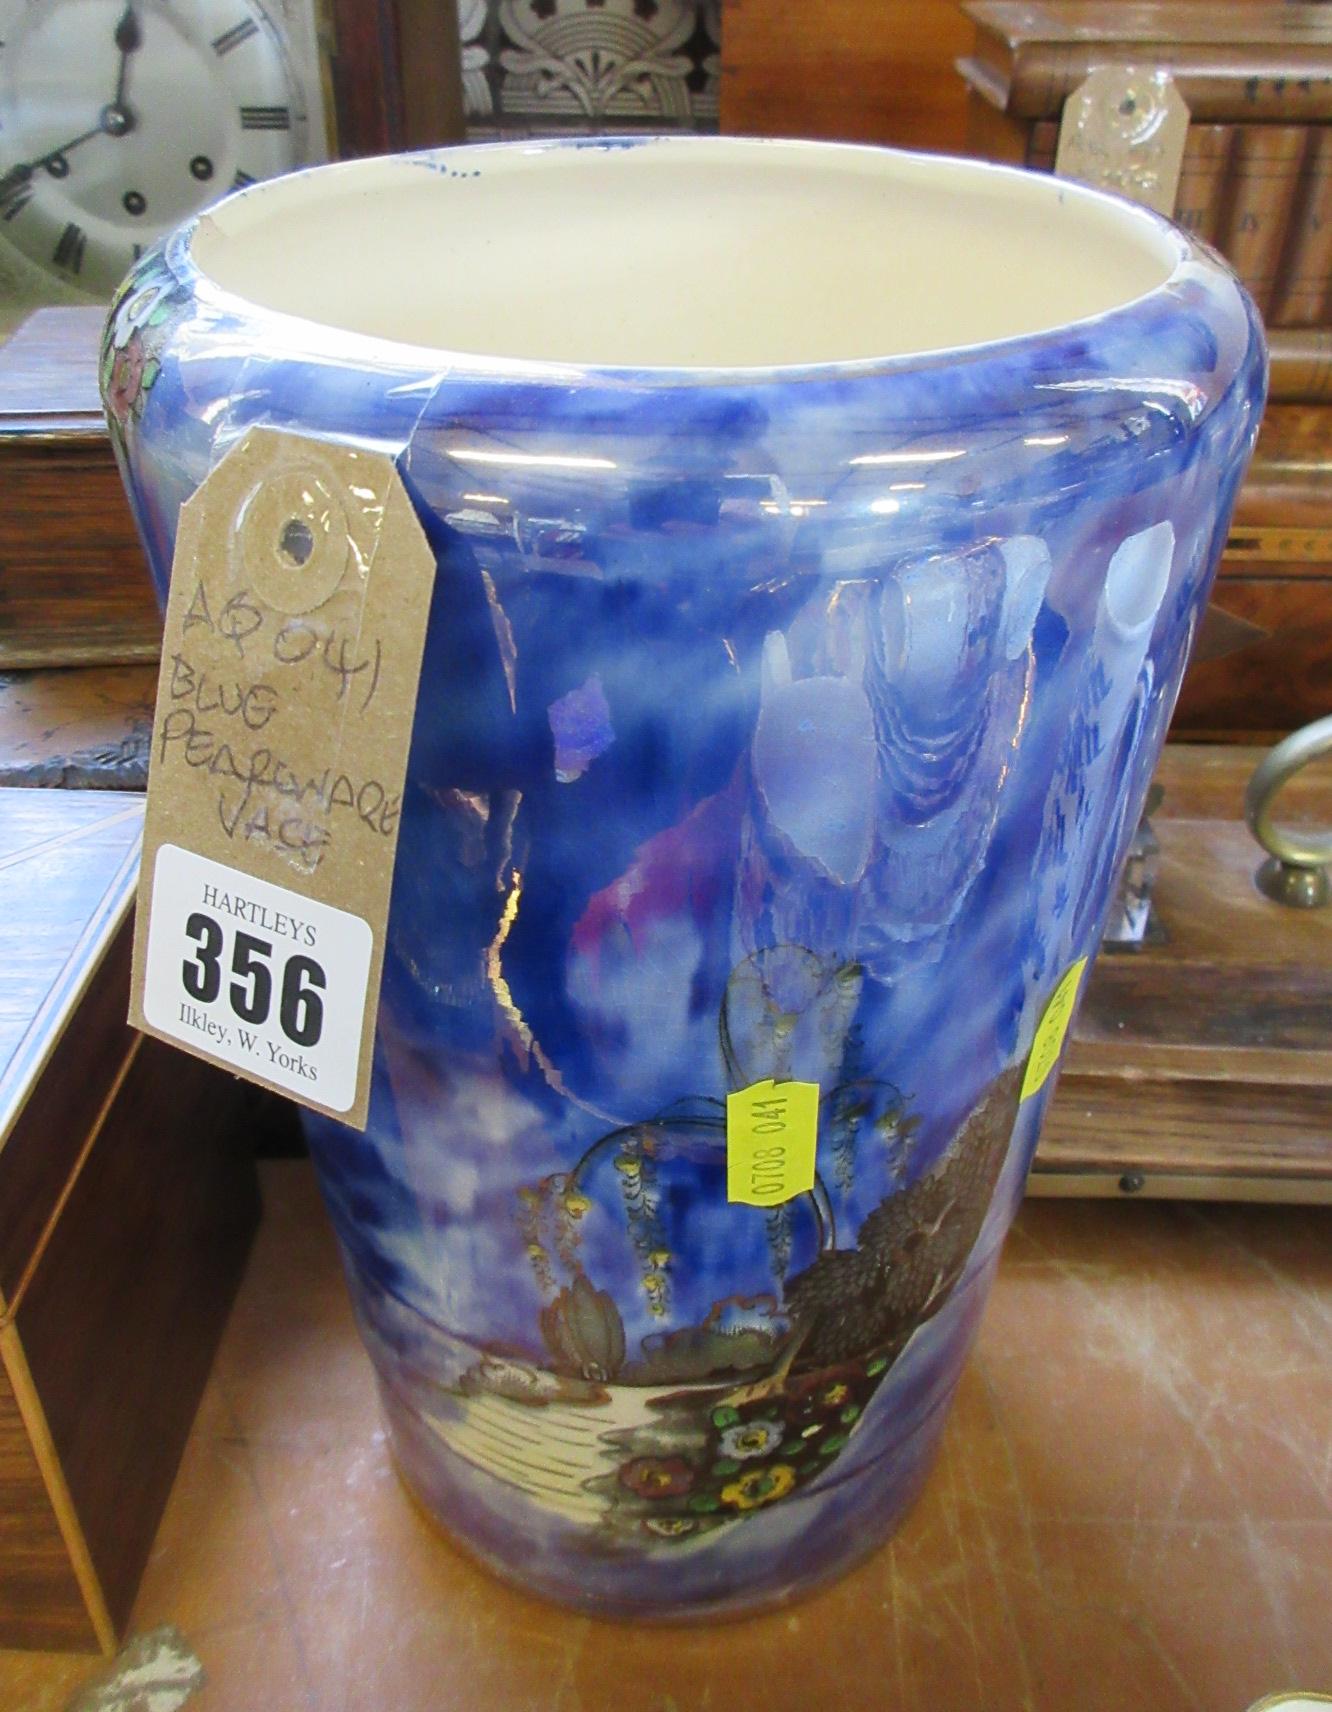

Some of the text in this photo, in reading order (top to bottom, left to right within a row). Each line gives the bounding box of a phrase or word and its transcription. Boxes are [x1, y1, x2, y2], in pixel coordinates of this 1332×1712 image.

[202, 884, 317, 947] HARTLEYS
[182, 912, 327, 1048] 356
[179, 1003, 318, 1082] Ilkley, W. Yorks
[751, 1098, 787, 1194] 0708 041
